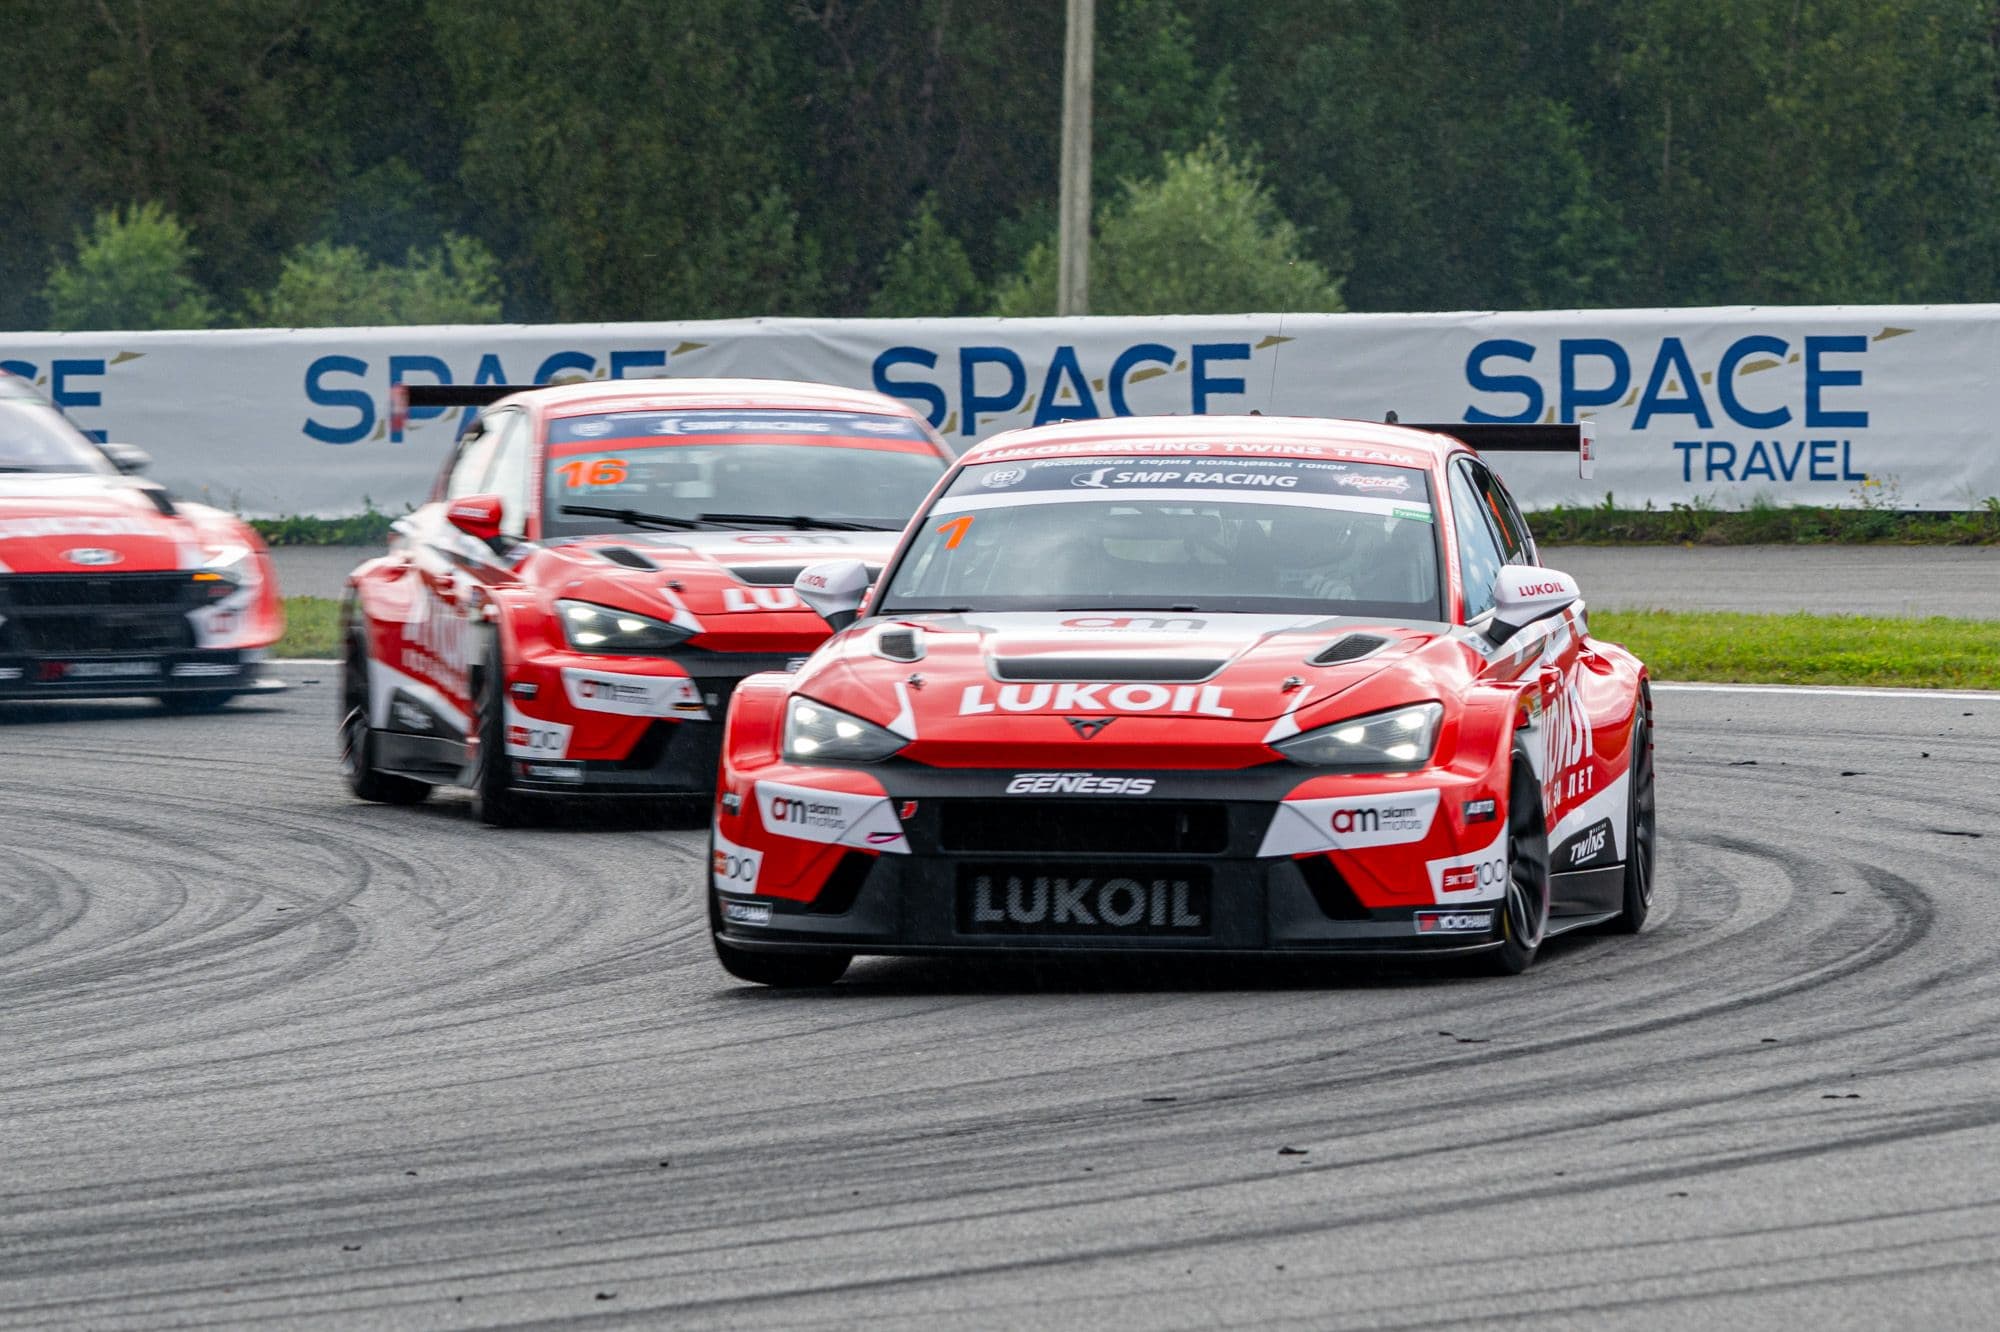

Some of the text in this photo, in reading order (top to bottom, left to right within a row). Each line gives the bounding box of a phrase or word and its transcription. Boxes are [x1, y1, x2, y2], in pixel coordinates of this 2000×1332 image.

[872, 343, 1249, 437] SPACE
[1463, 336, 1869, 430] SPACE
[977, 441, 1415, 464] LUKOIL RACING TWINS TEAM
[1139, 459, 1192, 467] серия
[1196, 460, 1293, 468] кольцевых
[1298, 463, 1349, 471] гонок
[1673, 440, 1866, 482] TRAVEL
[556, 458, 629, 488] 16
[1112, 471, 1298, 488] SMP RACING
[935, 515, 975, 550] 1
[1519, 582, 1565, 597] LUKOIL
[958, 683, 1234, 718] LUKOIL
[1005, 777, 1157, 795] GENESIS
[1567, 765, 1593, 799] ЛЕТ
[1331, 808, 1380, 834] am
[1570, 829, 1606, 862] TWINS
[974, 874, 1200, 926] LUKOIL
